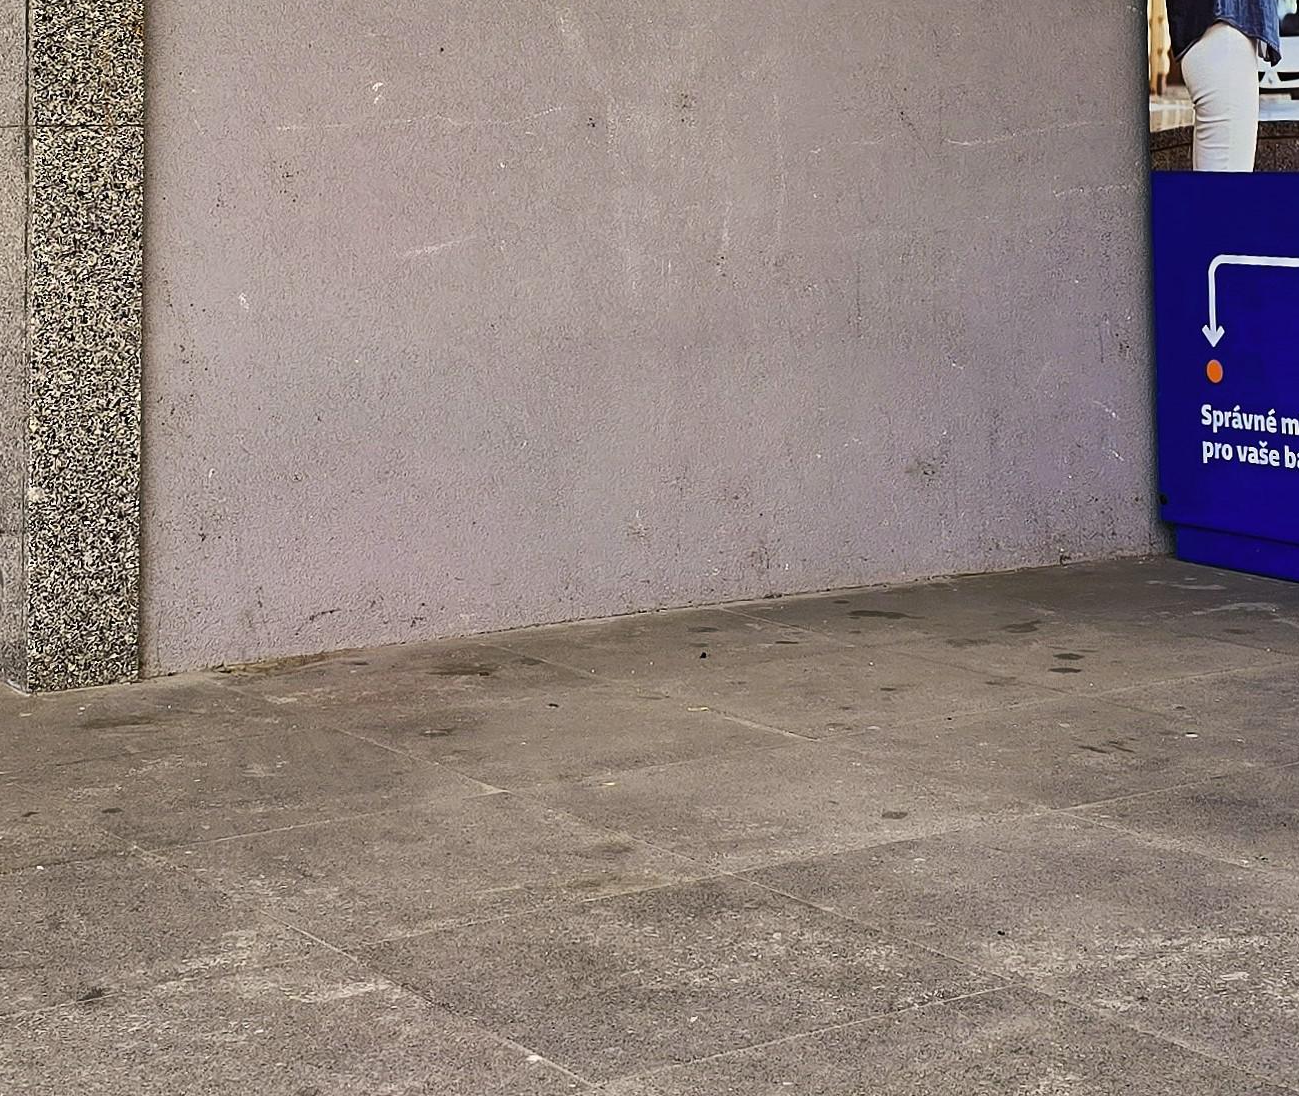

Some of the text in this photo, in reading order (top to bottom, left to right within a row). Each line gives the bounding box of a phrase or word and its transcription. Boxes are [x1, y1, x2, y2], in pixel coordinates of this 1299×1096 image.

[1201, 404, 1277, 433] Správné
[1202, 440, 1233, 464] pro
[1236, 440, 1280, 467] vaše
